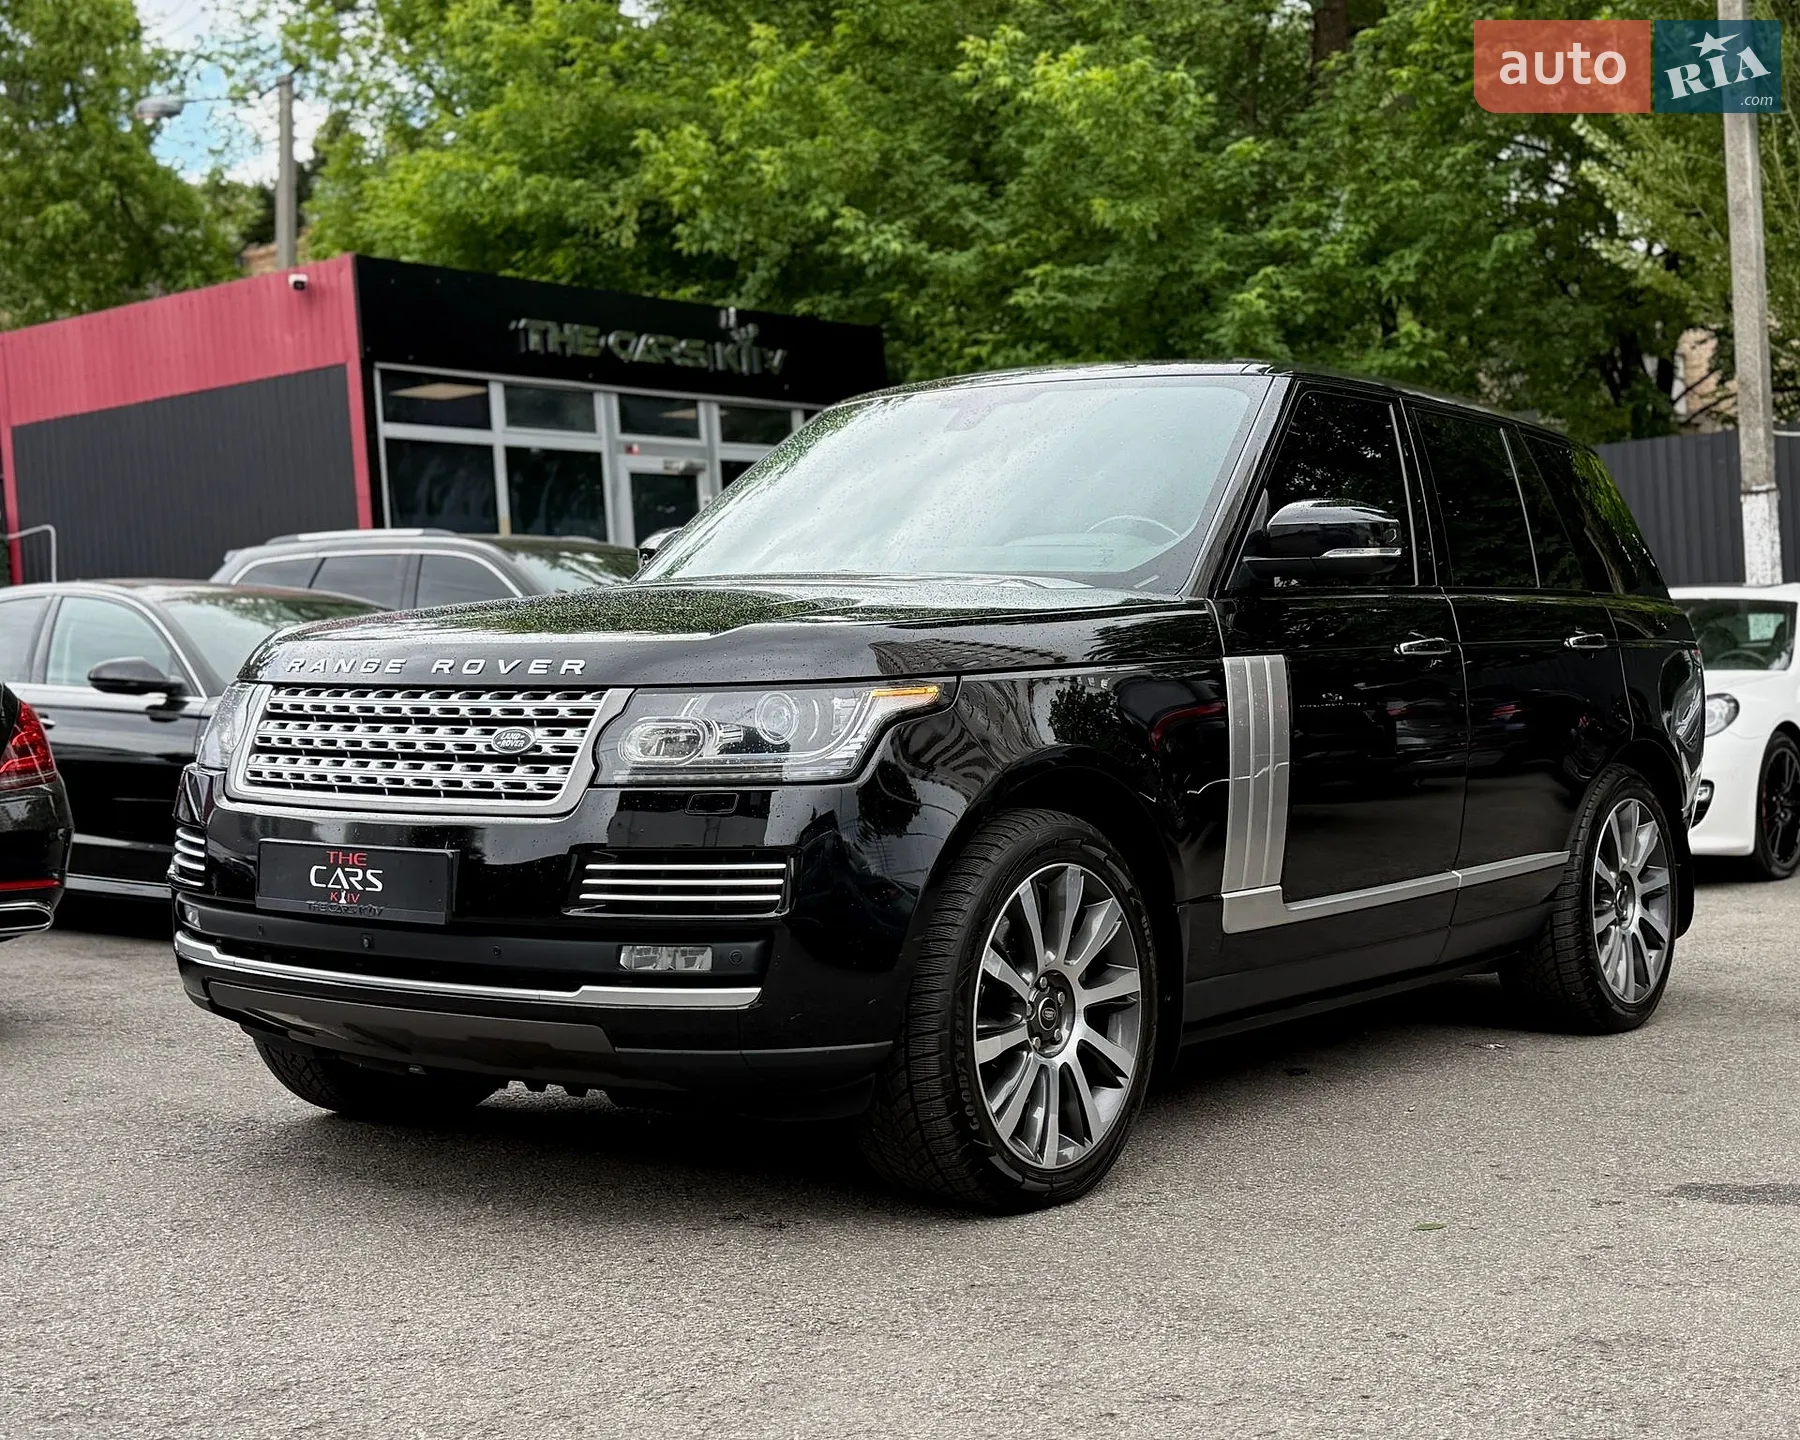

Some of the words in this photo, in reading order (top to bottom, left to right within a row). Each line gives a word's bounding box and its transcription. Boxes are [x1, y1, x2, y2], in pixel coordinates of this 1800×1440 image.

[511, 317, 602, 357] THE
[605, 329, 708, 367] CARS
[285, 657, 408, 674] RANGE
[430, 658, 587, 676] ROVER
[500, 732, 521, 740] LAND
[326, 851, 368, 866] THE
[309, 865, 384, 893] CARS
[953, 1000, 981, 1132] GOODYEAR
